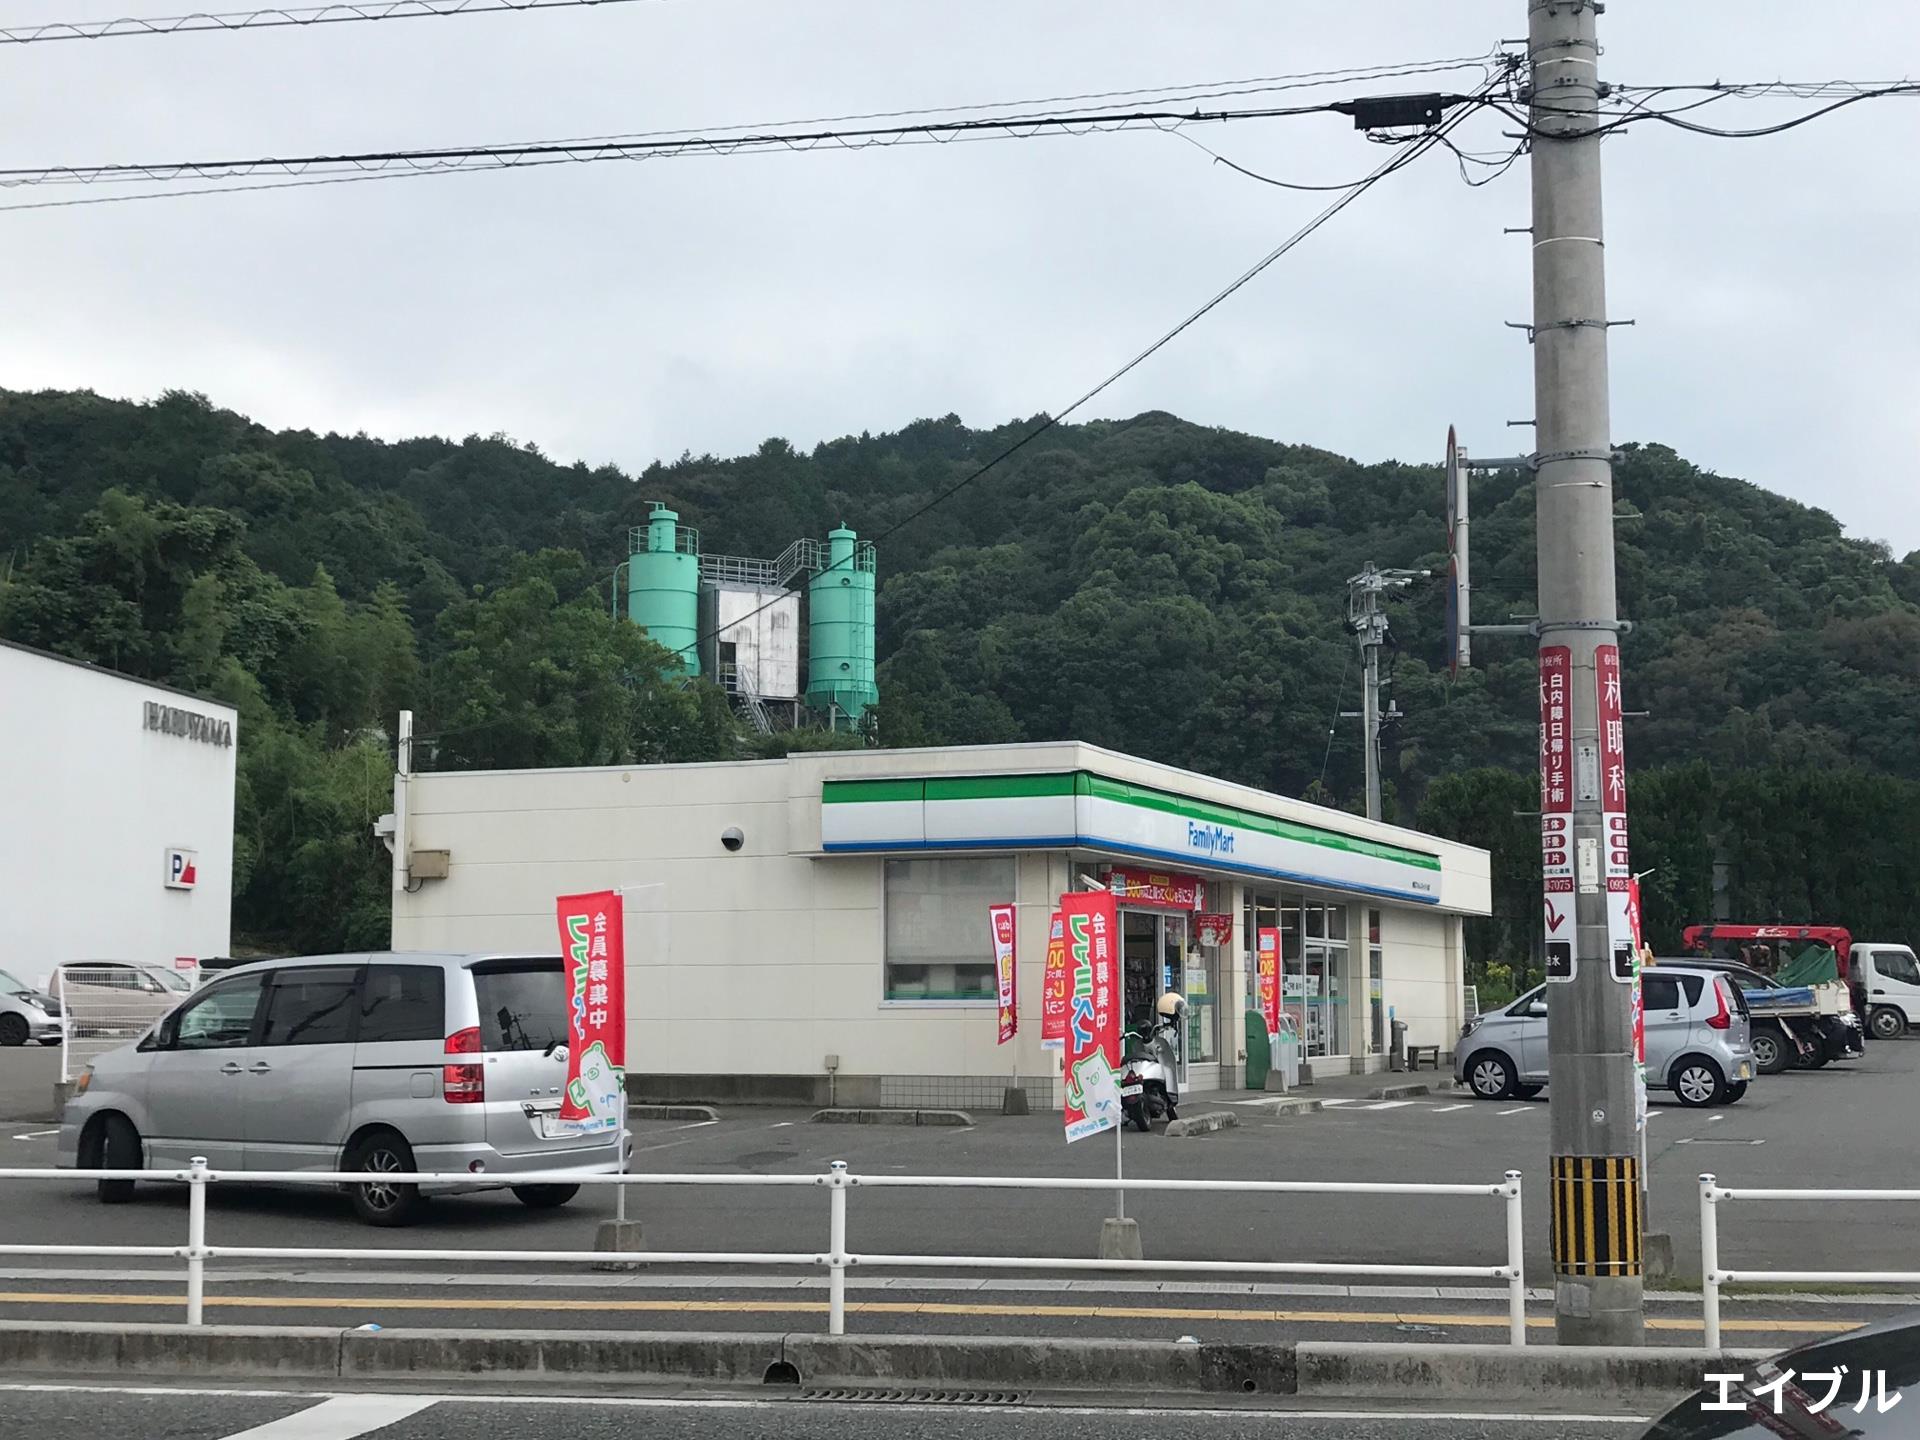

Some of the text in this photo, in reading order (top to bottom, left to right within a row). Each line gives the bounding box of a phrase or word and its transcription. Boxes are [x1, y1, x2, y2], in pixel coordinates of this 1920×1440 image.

[1550, 673, 1565, 803] 白内障日帰り手術
[1188, 821, 1234, 856] FamilyMart
[171, 854, 182, 882] P
